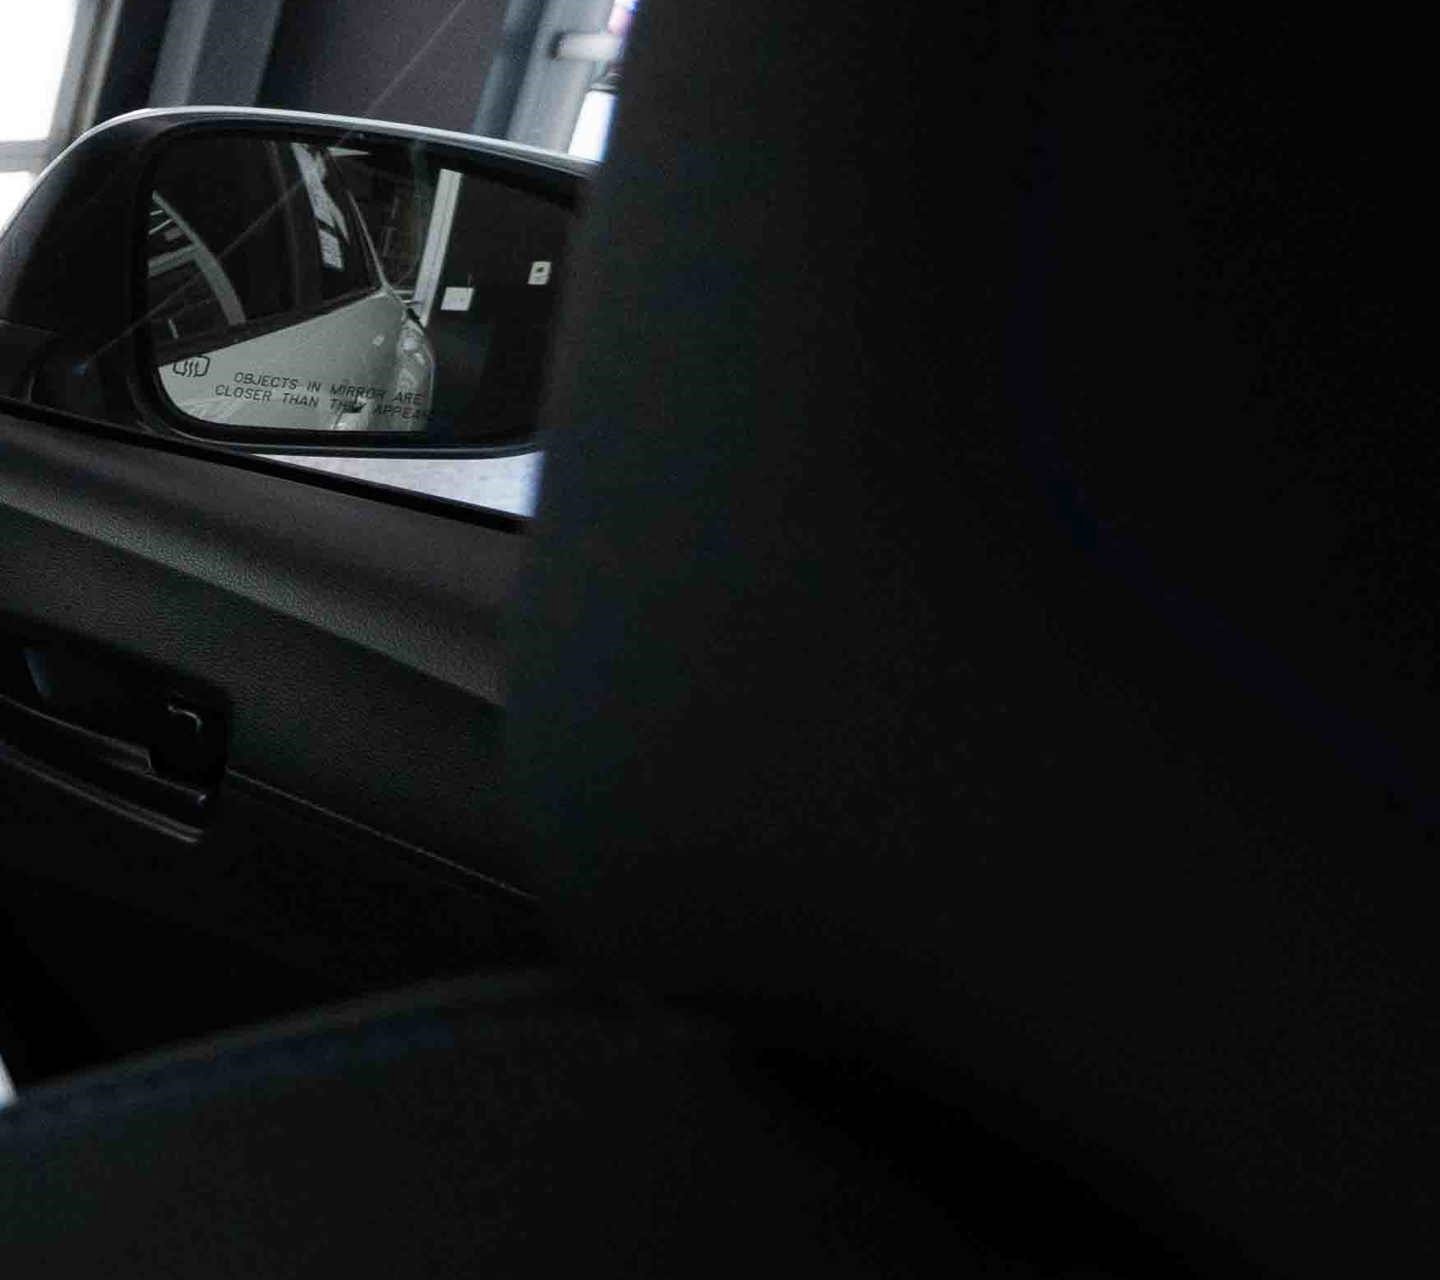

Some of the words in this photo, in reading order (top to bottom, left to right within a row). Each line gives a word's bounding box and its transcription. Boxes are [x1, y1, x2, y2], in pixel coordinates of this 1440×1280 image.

[215, 385, 272, 403] CLOSER
[282, 393, 319, 409] THAN
[233, 371, 299, 392] OBJECTS
[306, 378, 323, 392] IN
[330, 382, 387, 401] MIRROR
[394, 391, 426, 404] ARE
